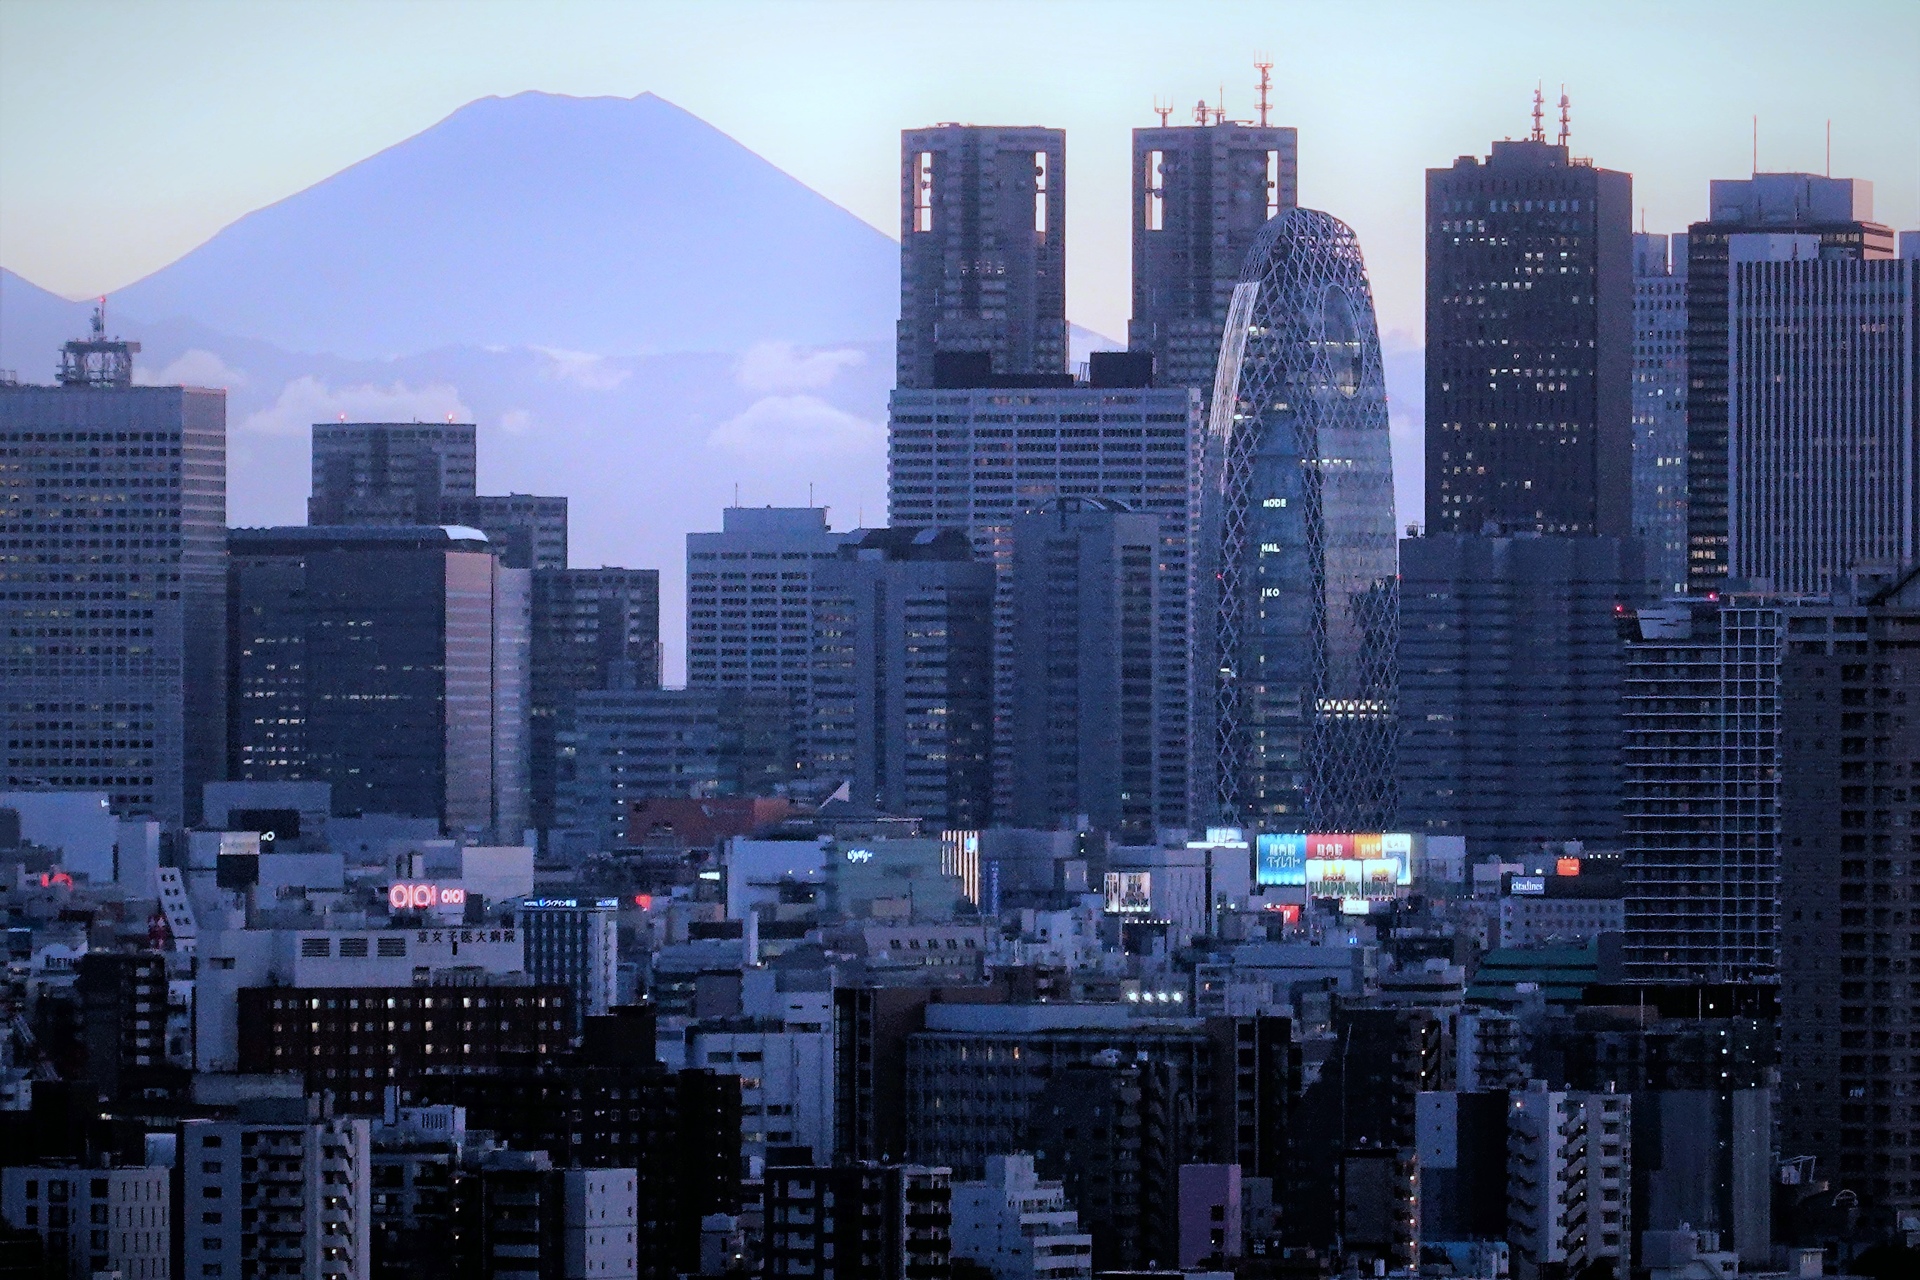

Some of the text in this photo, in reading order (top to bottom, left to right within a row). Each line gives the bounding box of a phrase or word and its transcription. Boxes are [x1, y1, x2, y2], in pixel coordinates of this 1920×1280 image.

[1263, 498, 1287, 508] MODE
[1261, 543, 1280, 553] HAL
[1261, 587, 1280, 597] IKO
